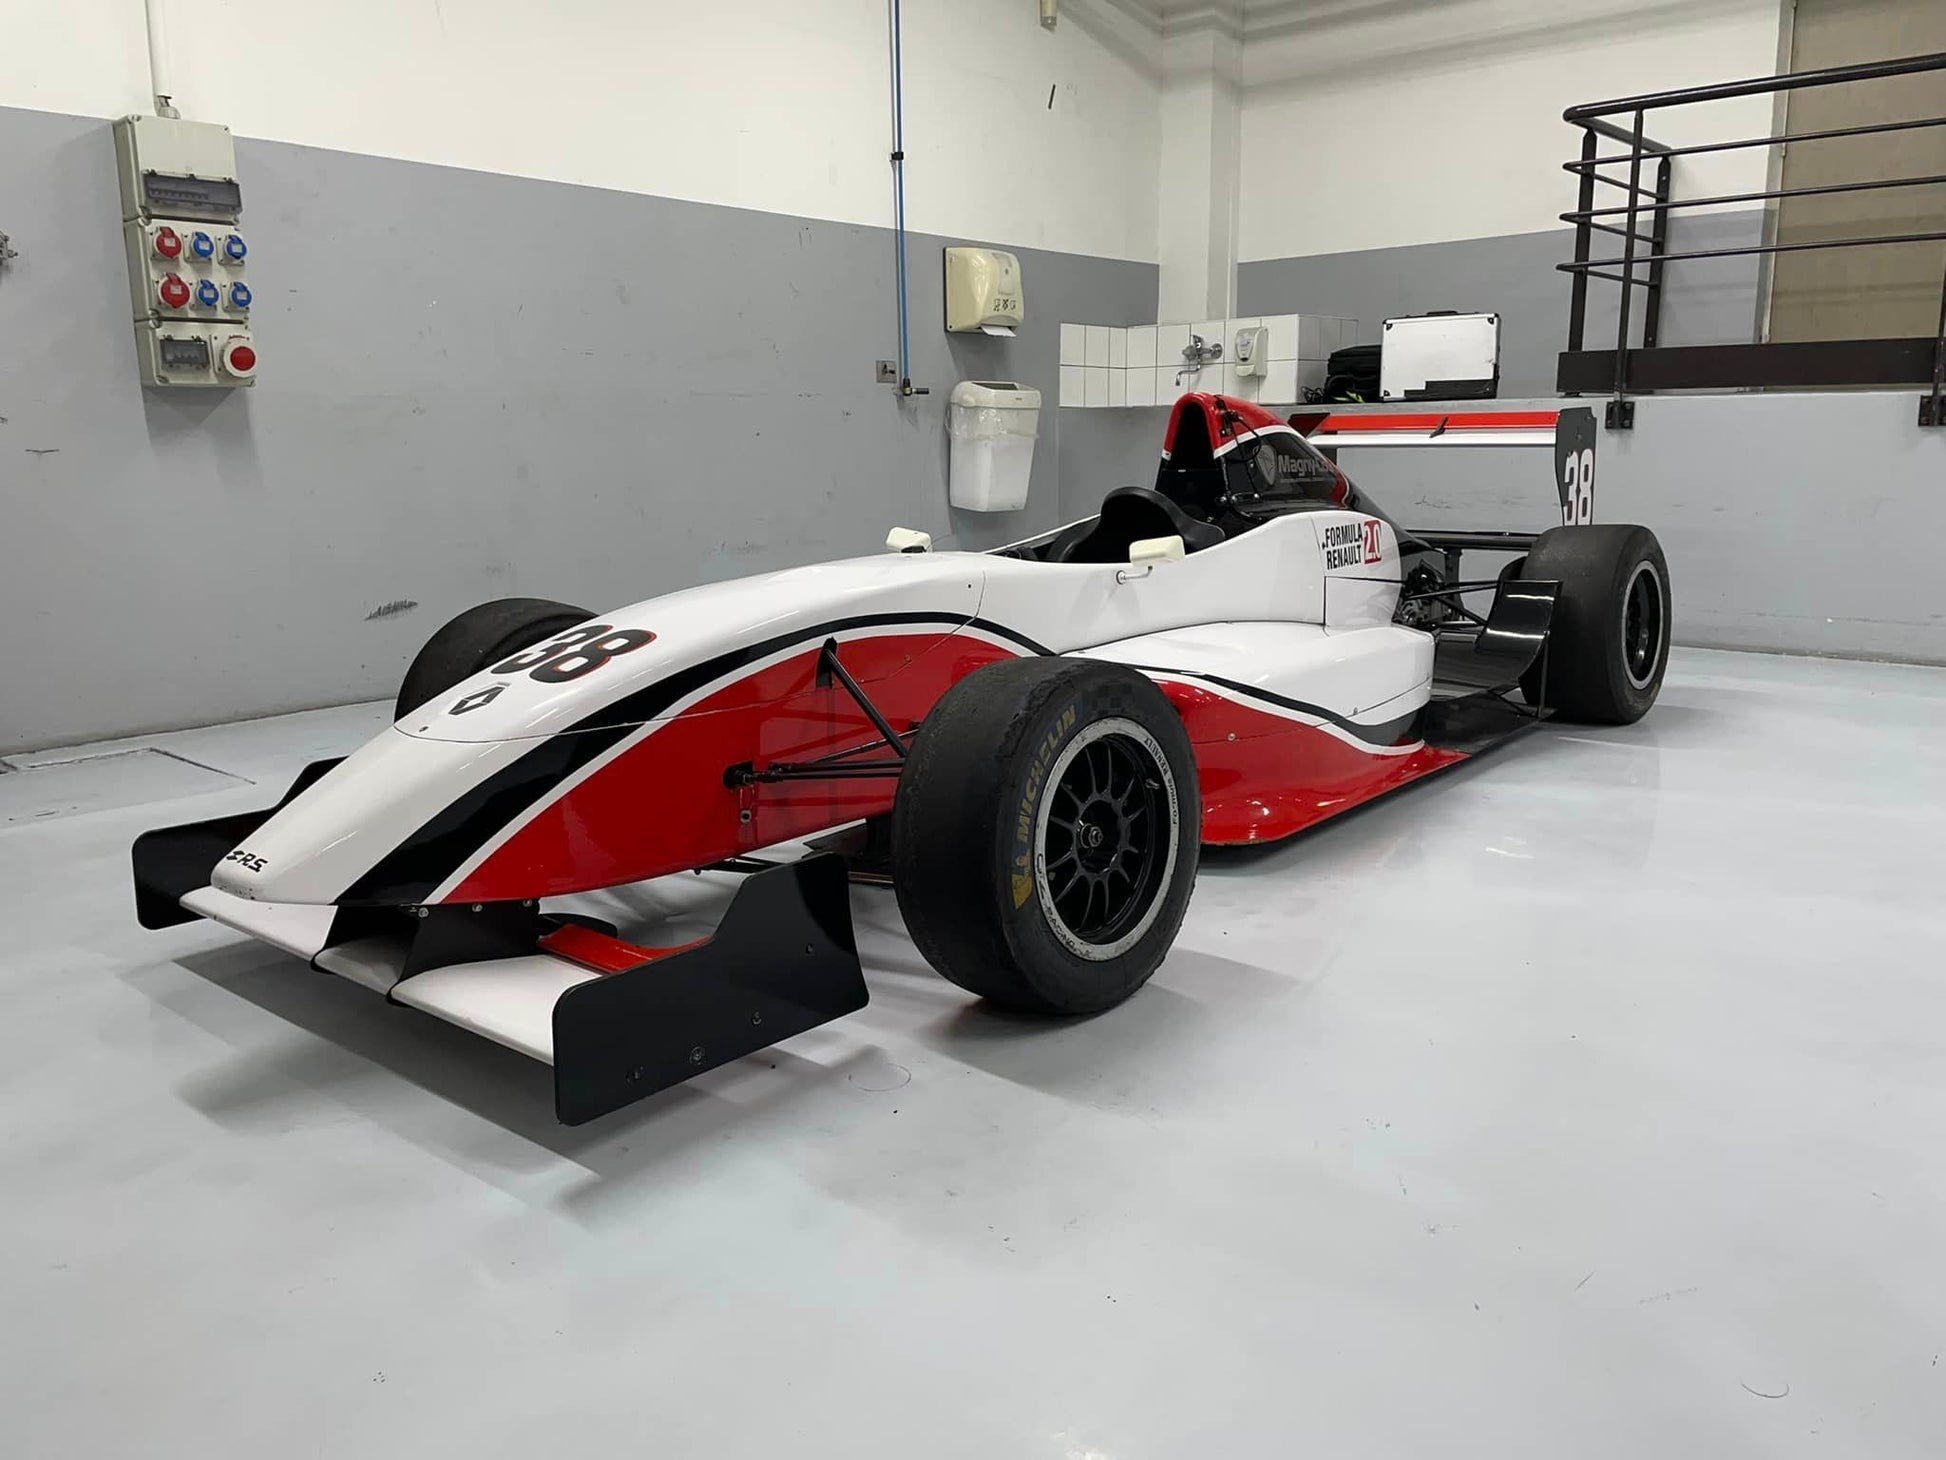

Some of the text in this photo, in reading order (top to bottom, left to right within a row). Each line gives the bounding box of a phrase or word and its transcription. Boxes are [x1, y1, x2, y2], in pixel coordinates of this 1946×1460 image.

[1563, 448, 1594, 526] 38
[1325, 522, 1363, 549] FORMULA
[1326, 544, 1362, 571] RENAULT
[490, 624, 658, 684] 38
[1016, 704, 1077, 844] MICHELIN
